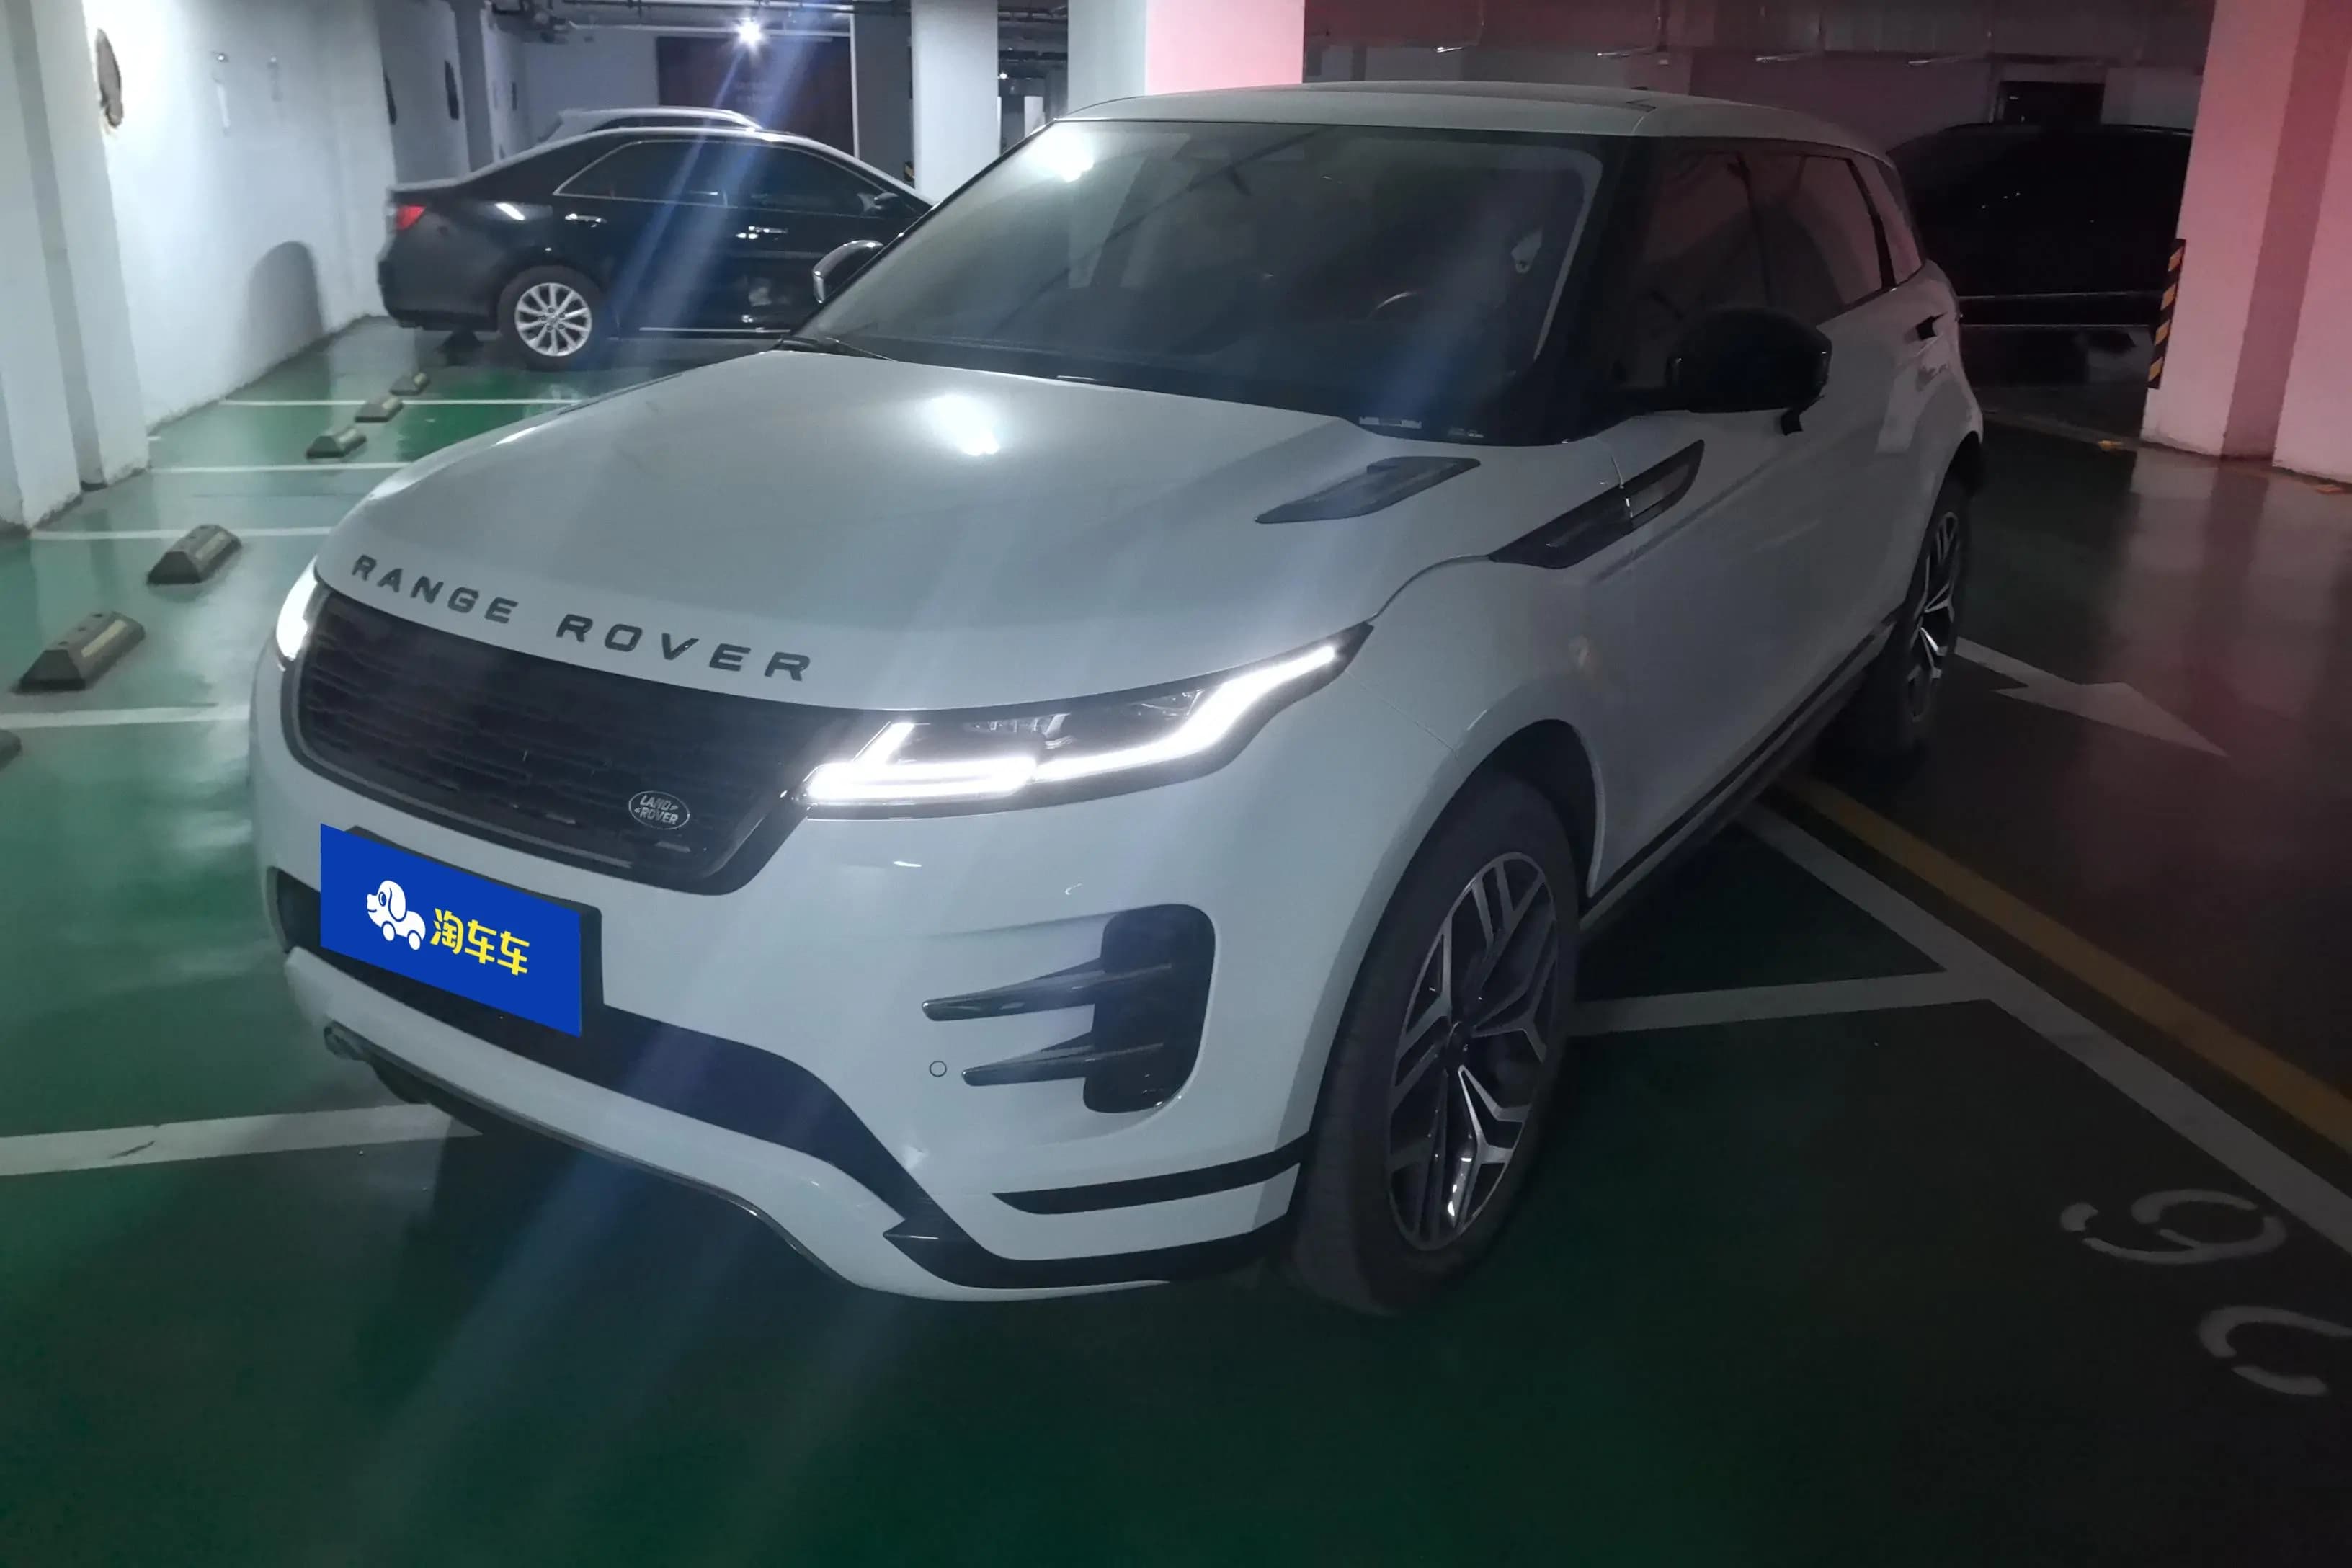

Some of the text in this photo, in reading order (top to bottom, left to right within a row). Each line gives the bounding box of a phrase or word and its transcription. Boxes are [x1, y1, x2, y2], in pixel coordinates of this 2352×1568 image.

[352, 555, 811, 682] RANGE ROVER
[639, 795, 672, 811] LAND
[639, 806, 679, 825] ROVER
